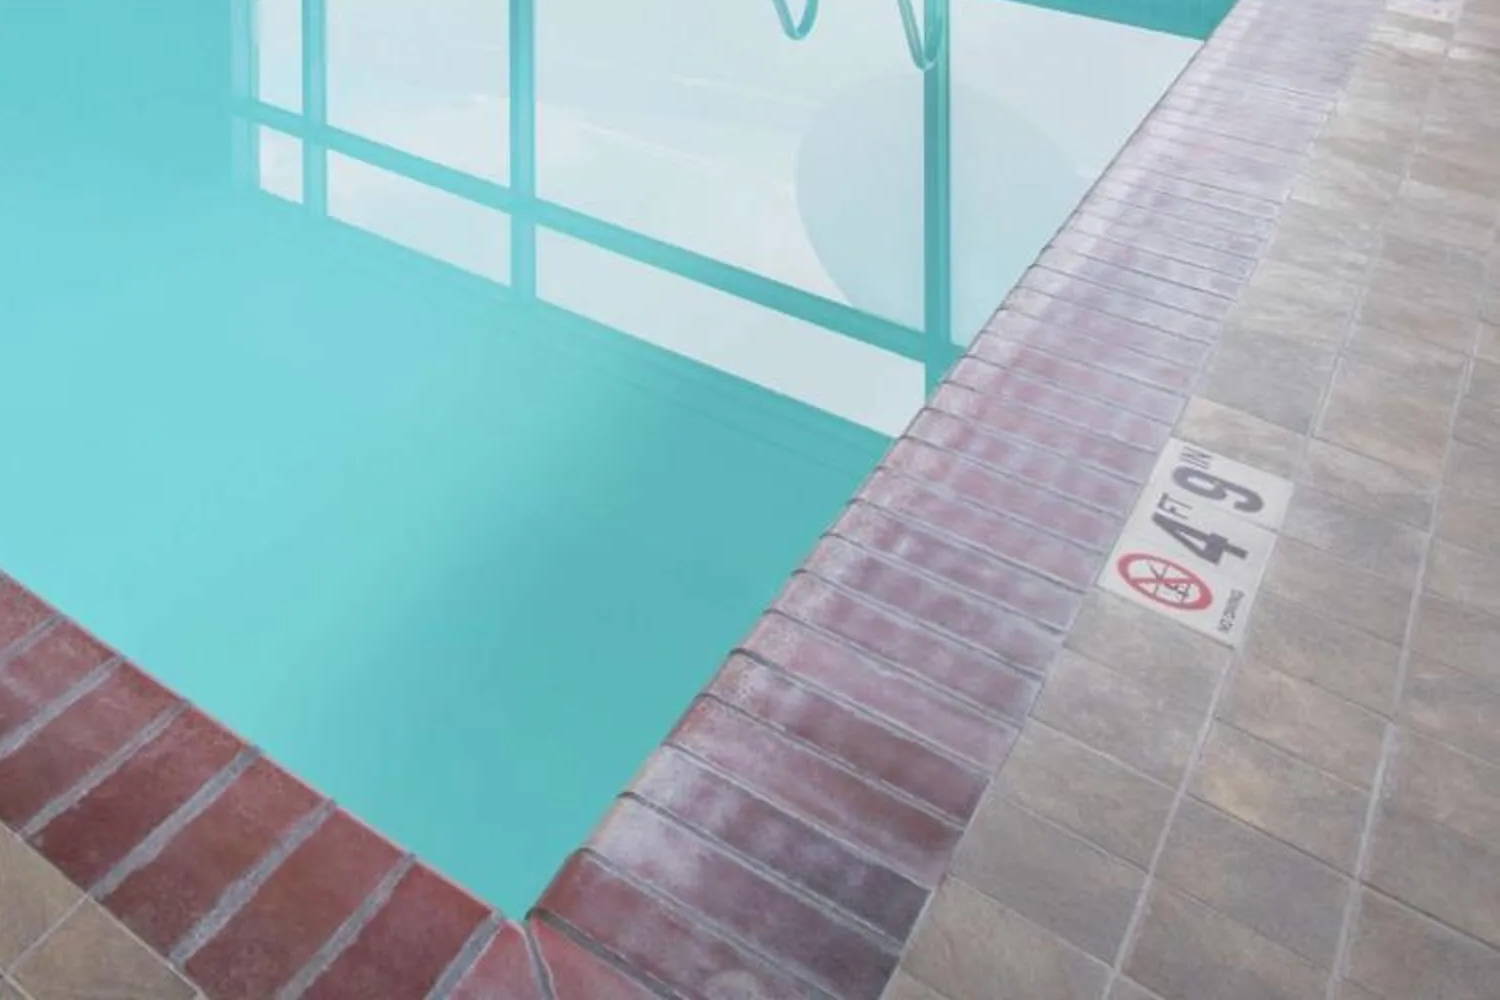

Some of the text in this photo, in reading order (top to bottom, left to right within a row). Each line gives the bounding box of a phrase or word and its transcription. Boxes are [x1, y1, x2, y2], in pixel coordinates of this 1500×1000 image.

[1151, 444, 1265, 566] 4 FT 9 IN
